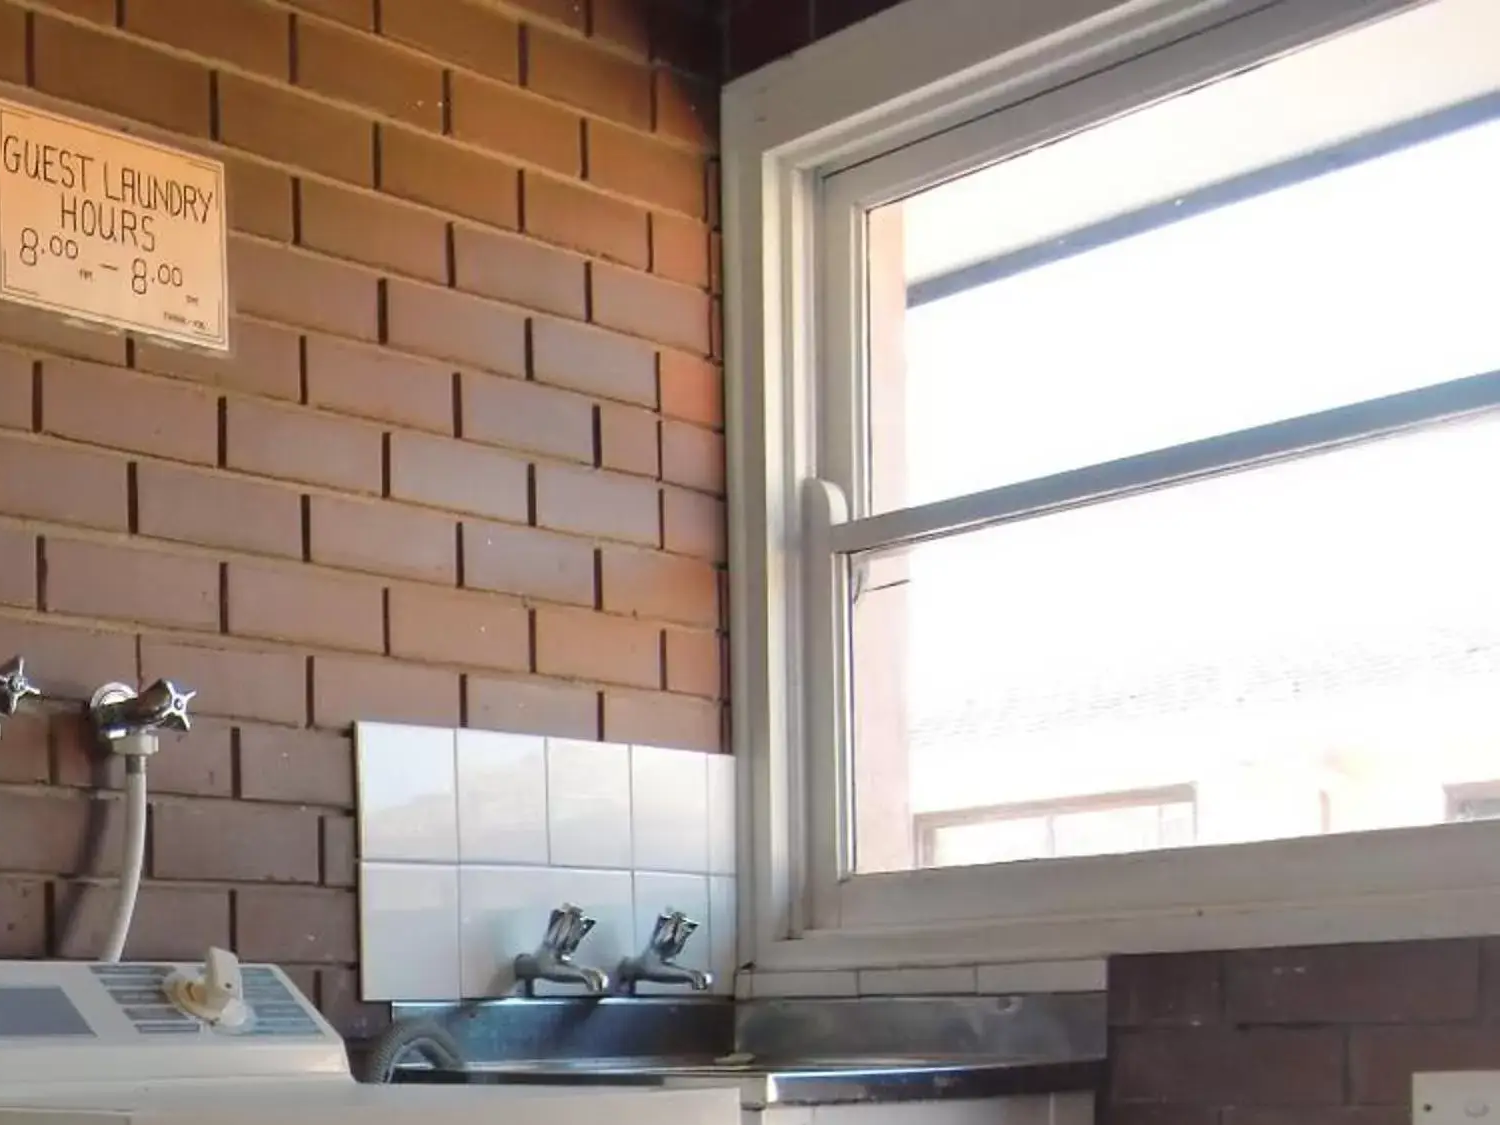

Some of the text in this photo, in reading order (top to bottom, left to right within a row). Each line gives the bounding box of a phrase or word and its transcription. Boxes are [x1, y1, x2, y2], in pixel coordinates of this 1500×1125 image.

[3, 135, 213, 224] GUEST LAUNDRY
[60, 191, 155, 252] HOURS
[19, 227, 79, 267] 8.00
[131, 257, 183, 295] 8.00
